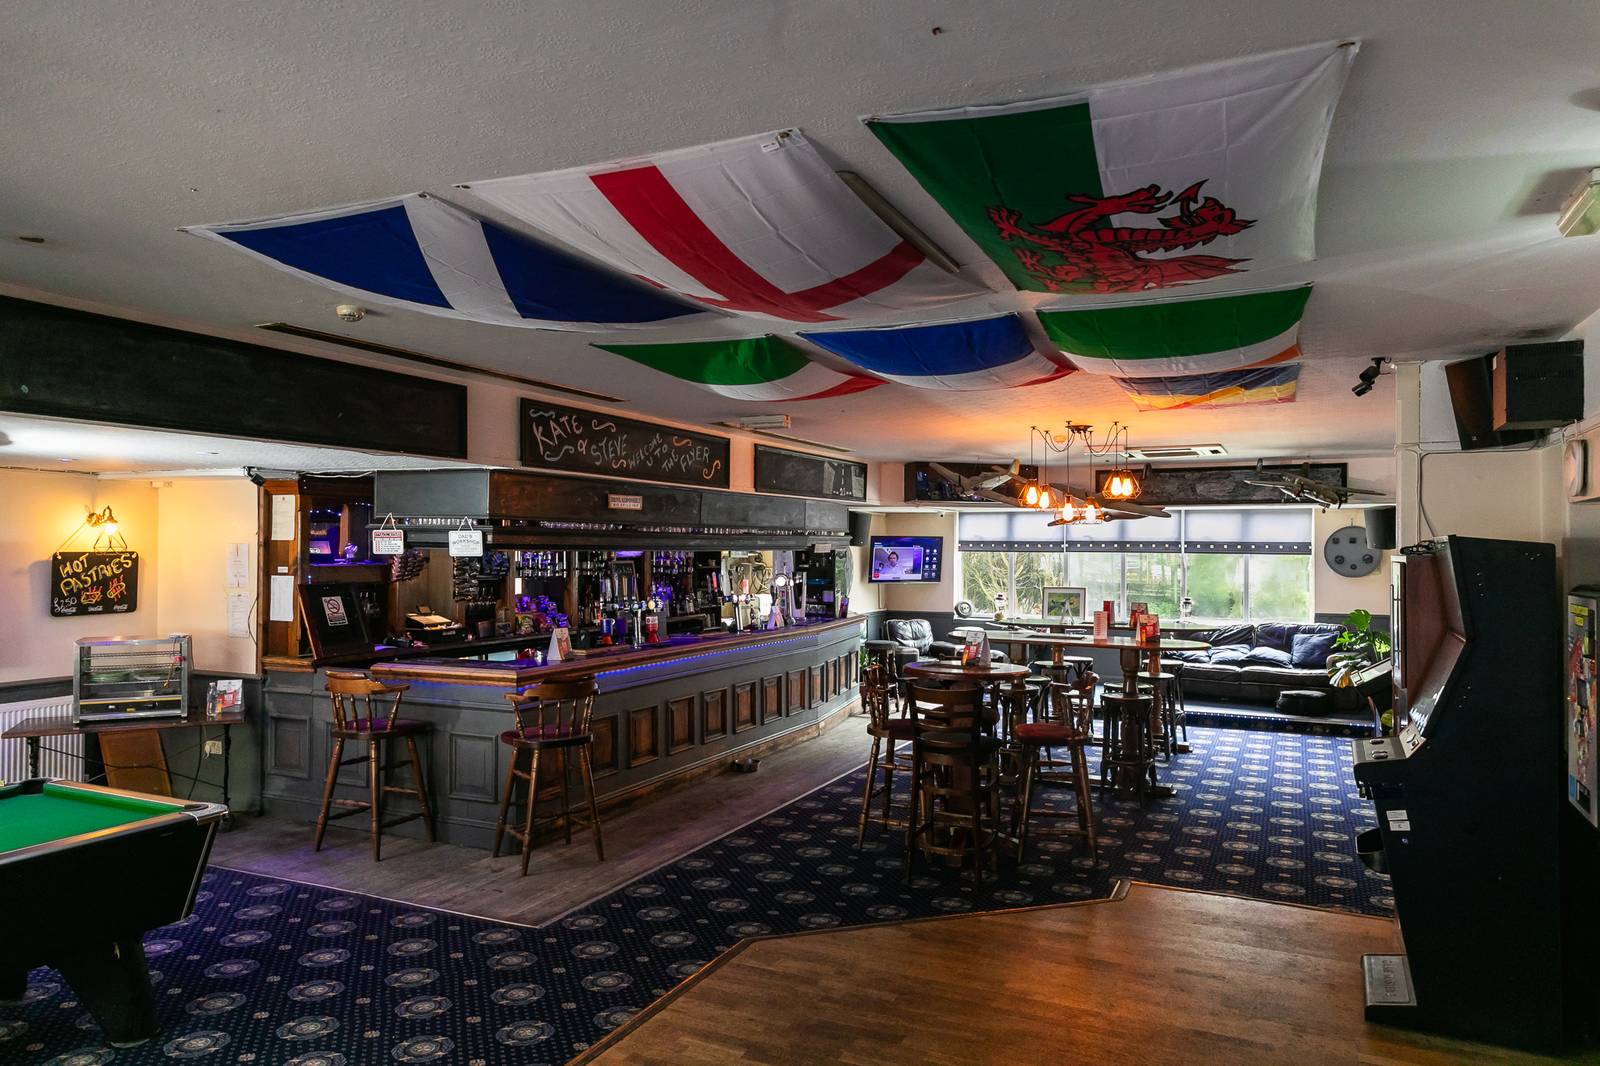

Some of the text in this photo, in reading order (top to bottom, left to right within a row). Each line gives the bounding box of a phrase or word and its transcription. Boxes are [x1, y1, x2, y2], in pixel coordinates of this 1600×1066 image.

[533, 415, 583, 456] KATE
[591, 433, 628, 466] STEVE
[661, 449, 679, 472] THE
[680, 446, 710, 473] FLYER
[60, 553, 89, 578] HOT
